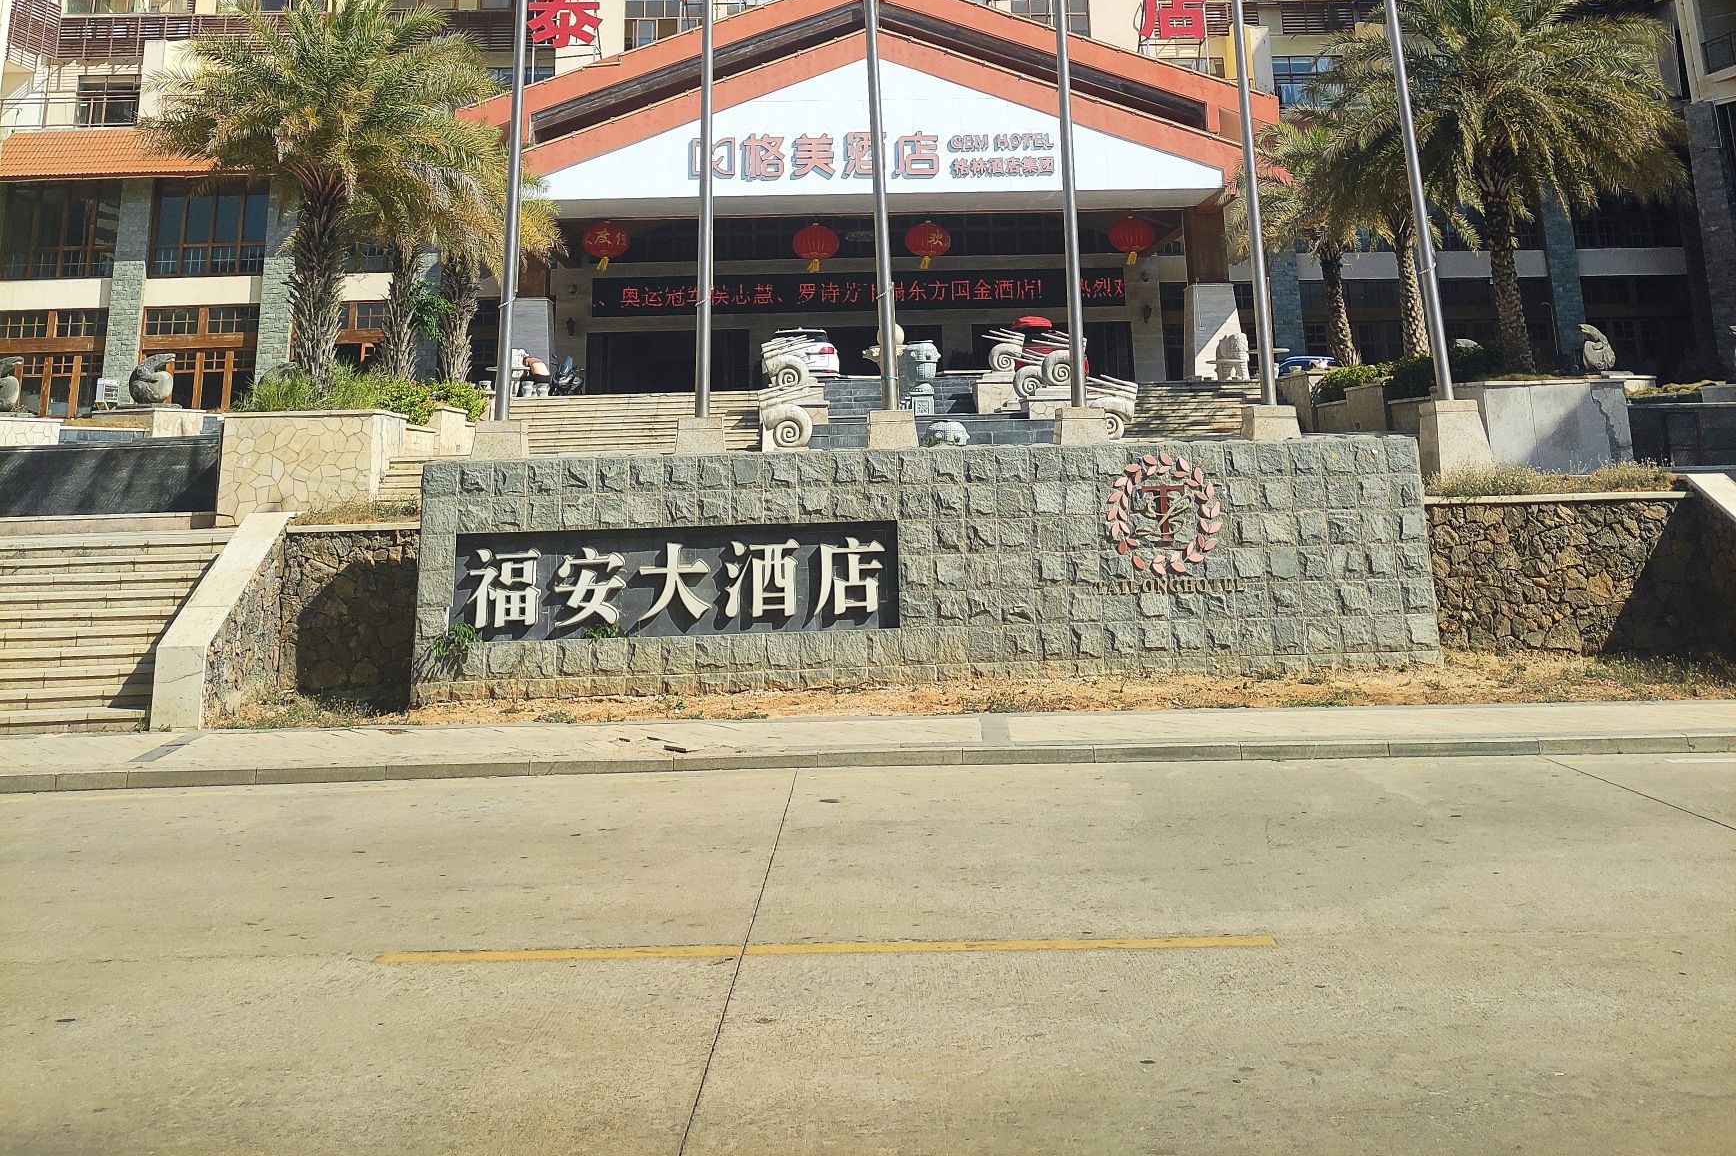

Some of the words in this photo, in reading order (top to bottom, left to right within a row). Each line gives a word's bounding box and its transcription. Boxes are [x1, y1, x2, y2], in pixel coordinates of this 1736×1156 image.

[741, 130, 939, 181] 格美酒店
[948, 134, 989, 152] GEM
[993, 133, 1055, 151] HOTEL
[950, 156, 1055, 178] 格林酒店集团
[467, 536, 886, 629] 福安大酒店
